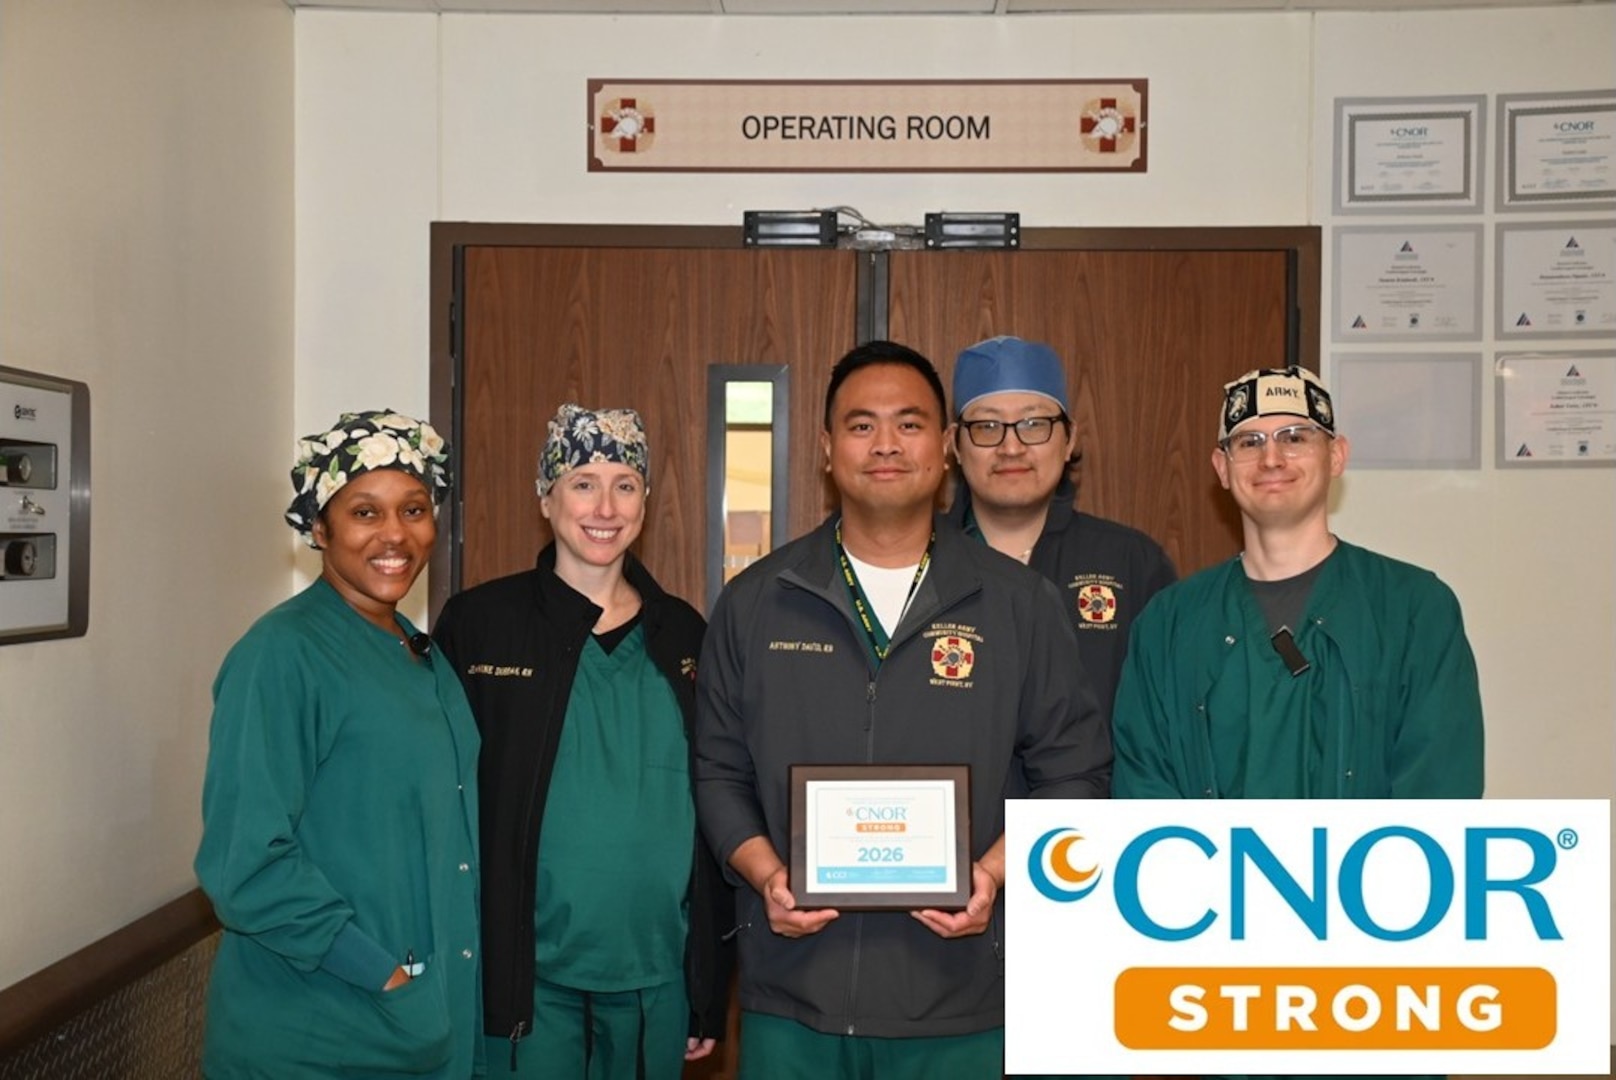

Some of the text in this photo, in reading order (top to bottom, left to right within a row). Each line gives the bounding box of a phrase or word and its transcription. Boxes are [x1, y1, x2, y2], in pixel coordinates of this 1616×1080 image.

[741, 115, 991, 140] OPERATING ROOM
[1265, 386, 1298, 398] ARMY
[855, 806, 907, 821] CNOR
[857, 847, 905, 862] 2026
